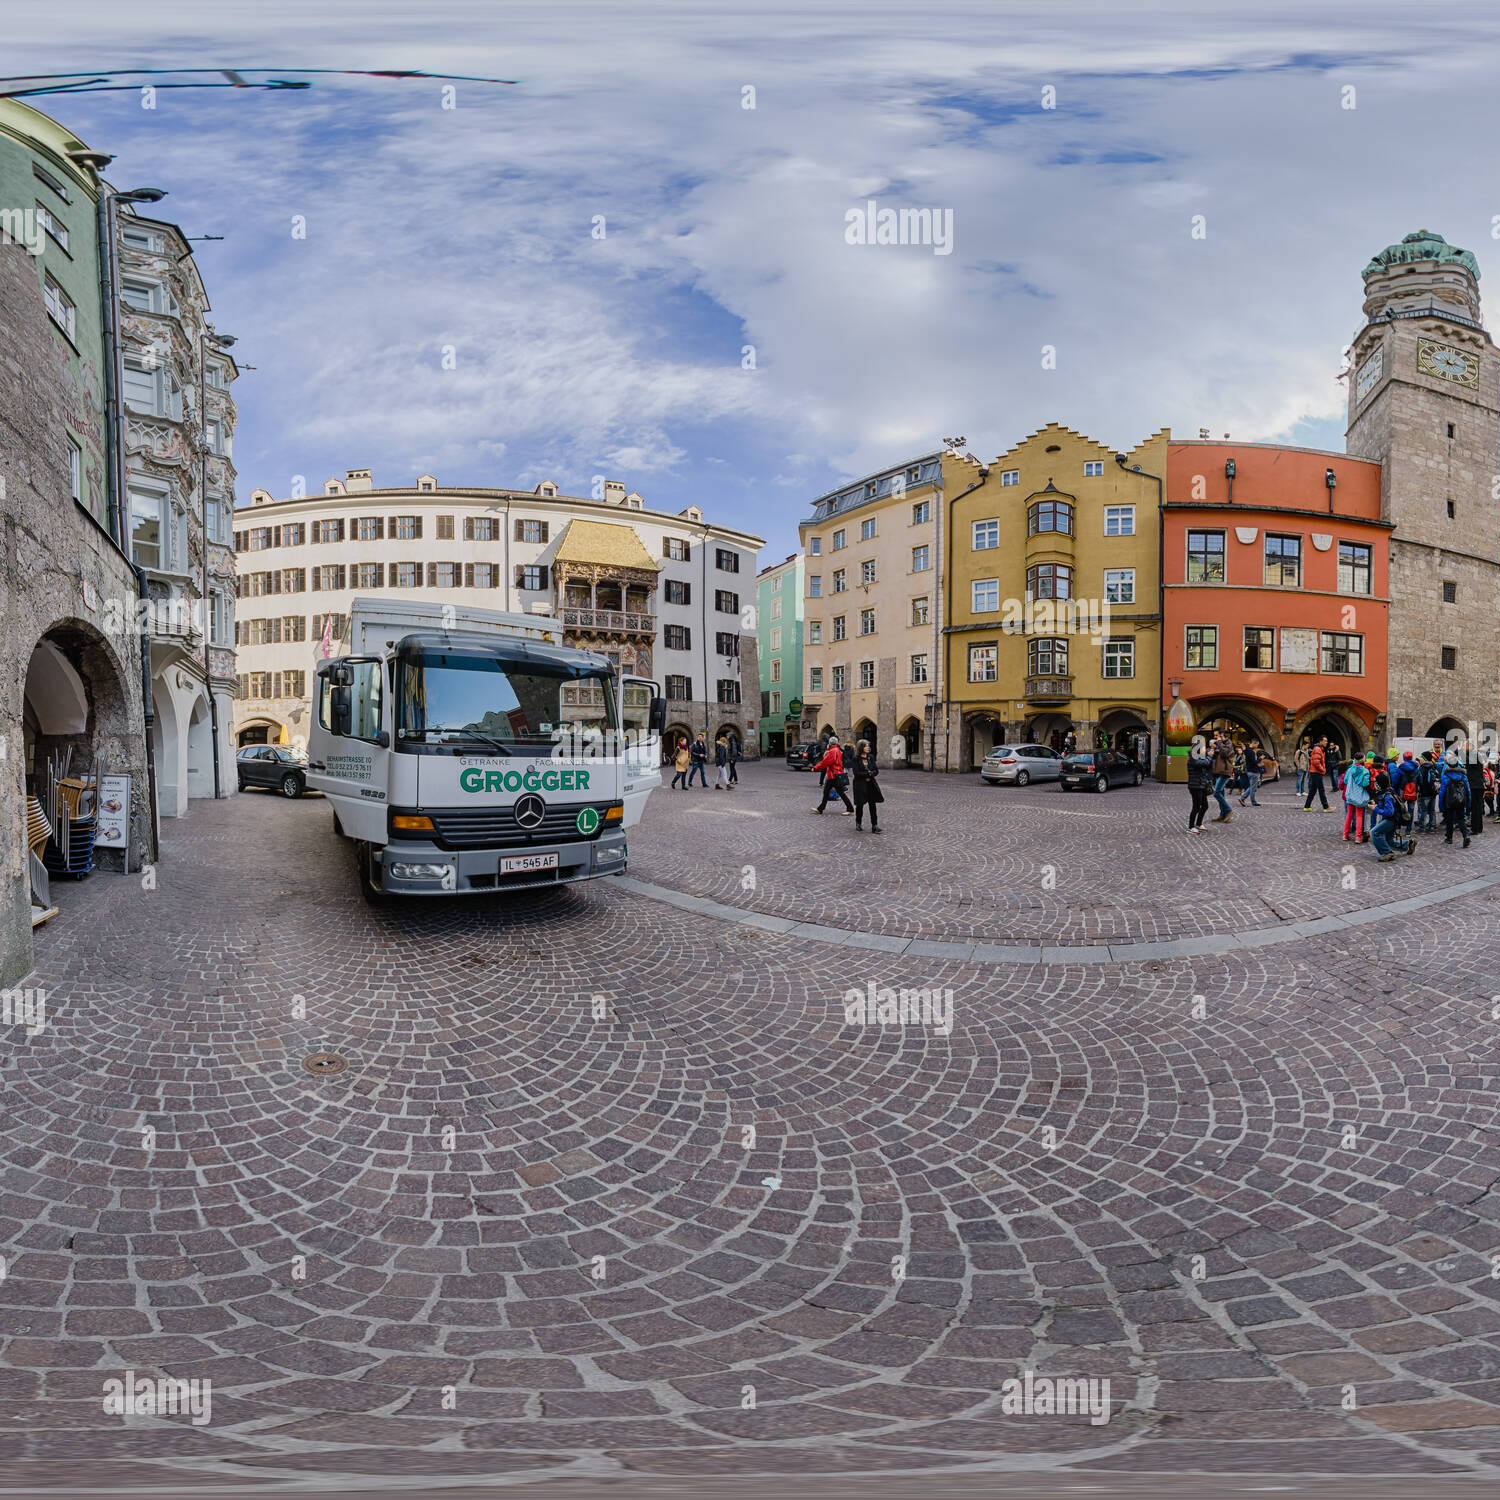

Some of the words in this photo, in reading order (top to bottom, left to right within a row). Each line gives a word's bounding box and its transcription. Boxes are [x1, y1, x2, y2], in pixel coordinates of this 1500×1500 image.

[460, 768, 590, 793] GROGGER
[583, 813, 593, 829] L
[505, 860, 514, 870] IL
[523, 857, 541, 869] 545
[543, 856, 554, 867] AF
